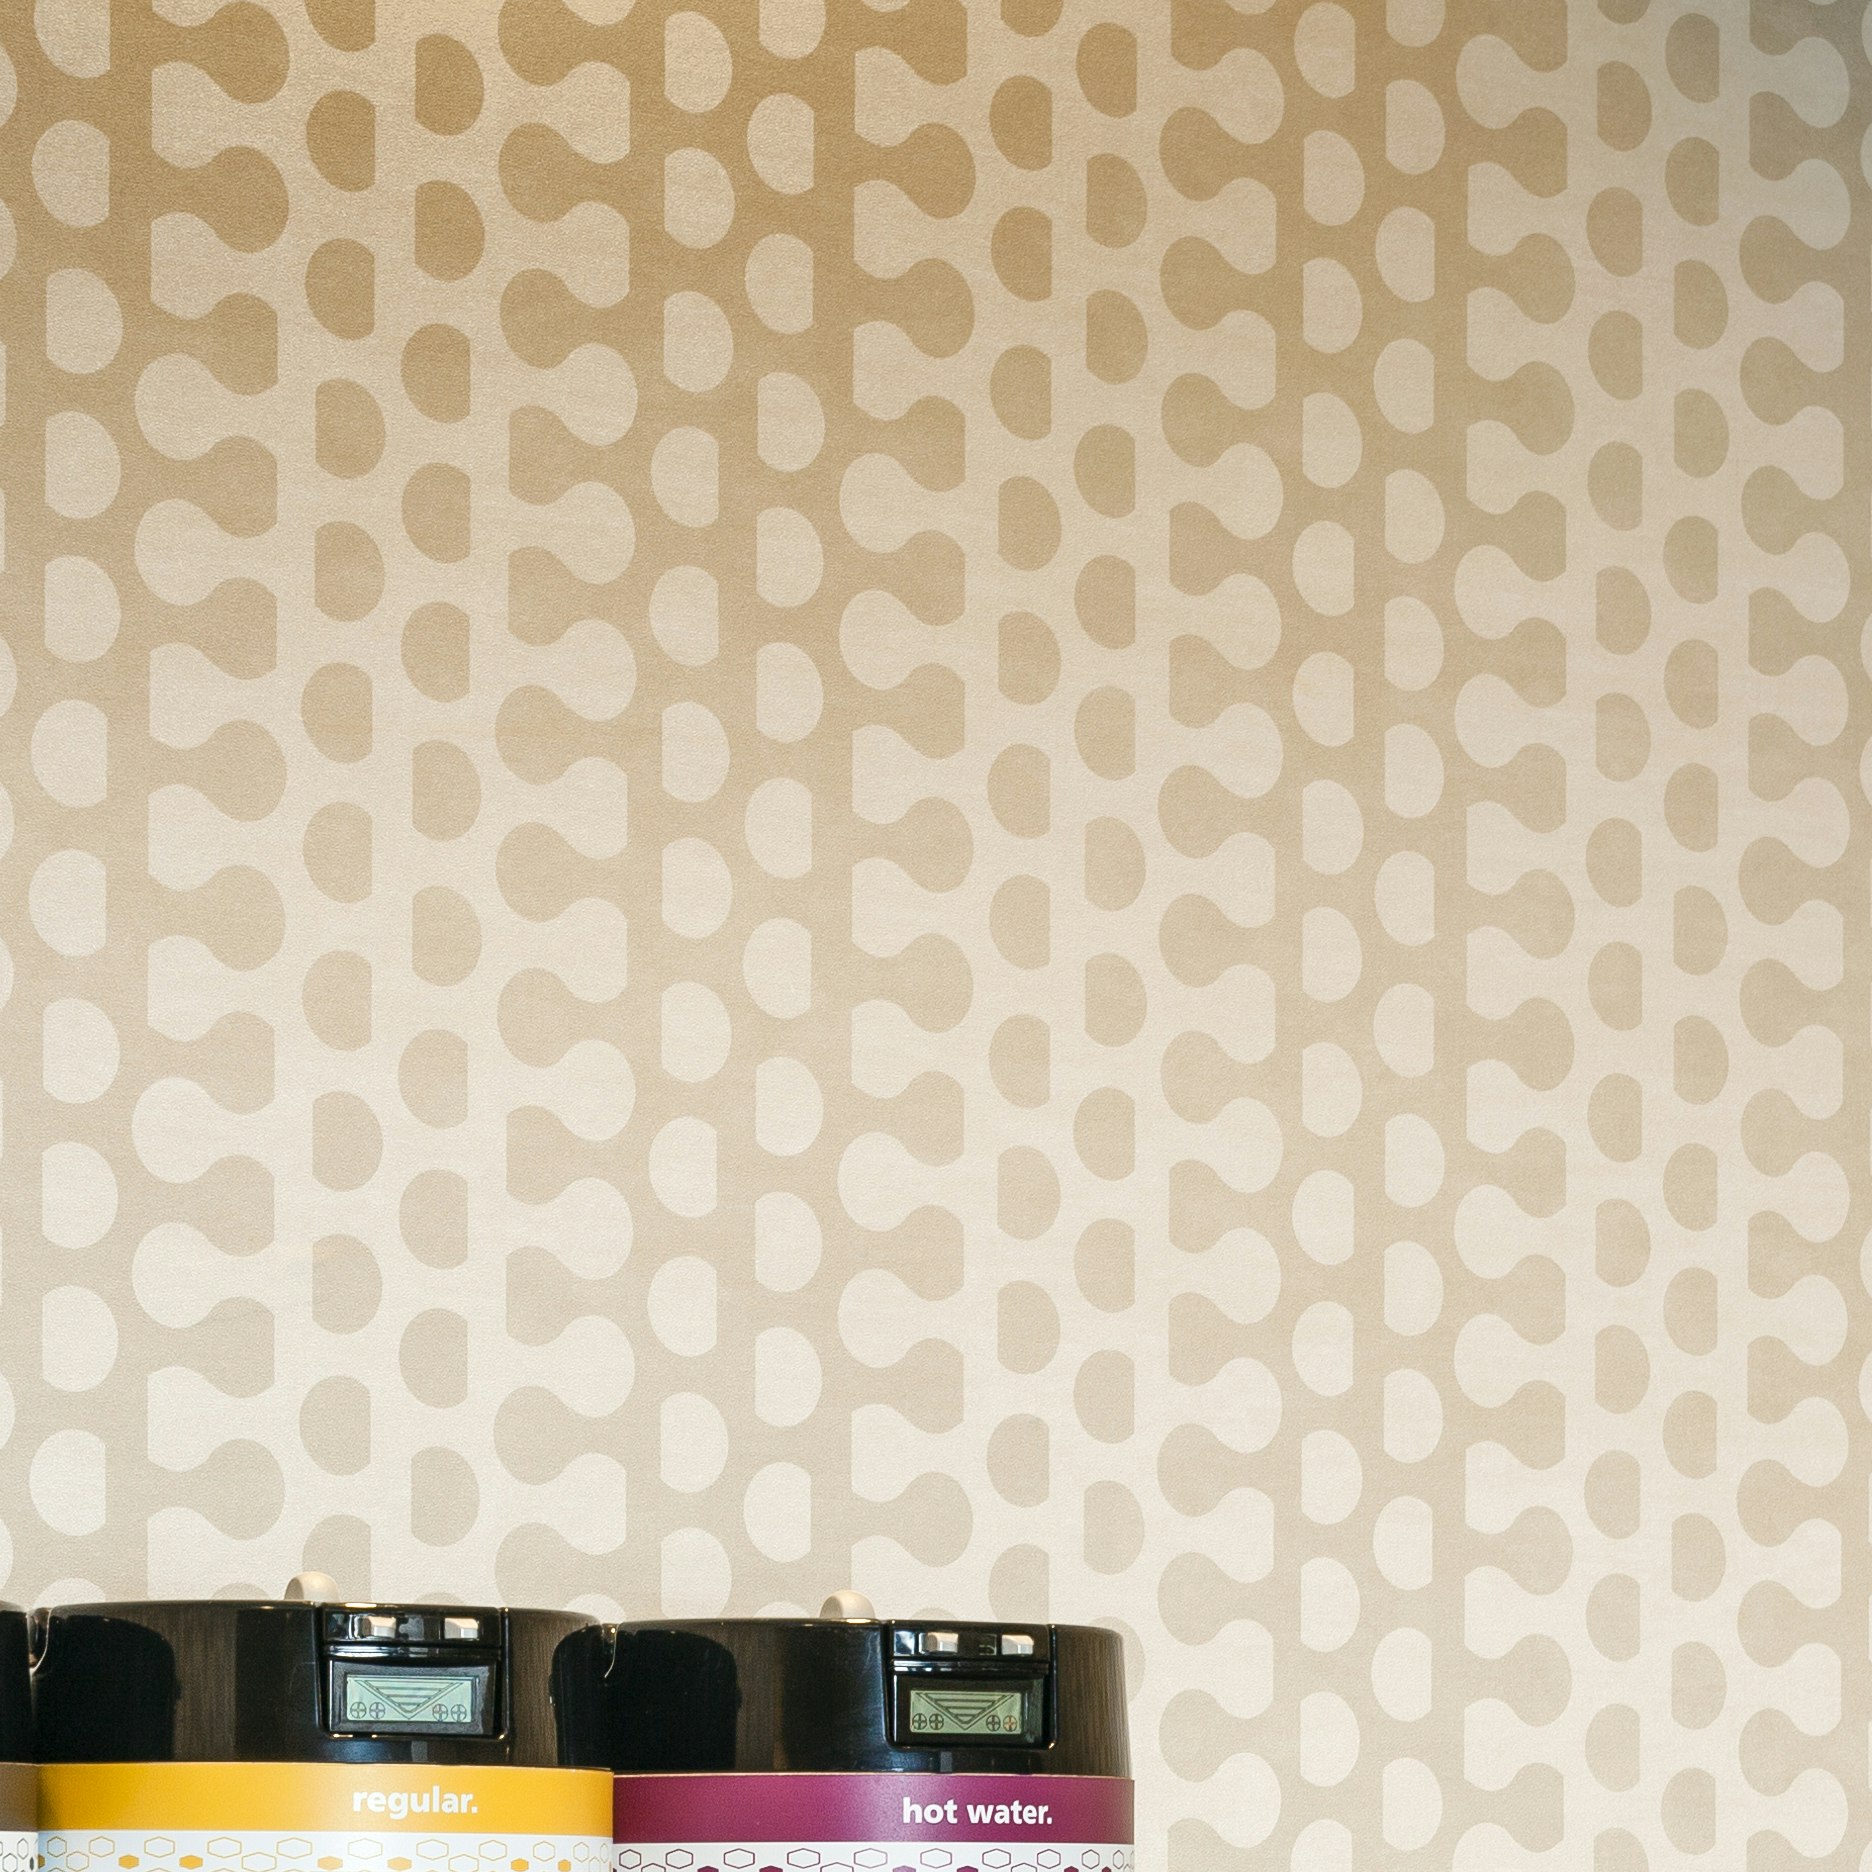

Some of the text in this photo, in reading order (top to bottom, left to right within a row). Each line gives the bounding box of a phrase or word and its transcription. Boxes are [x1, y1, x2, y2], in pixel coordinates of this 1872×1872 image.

[352, 1784, 478, 1820] regular.
[902, 1796, 1053, 1825] hot water.
